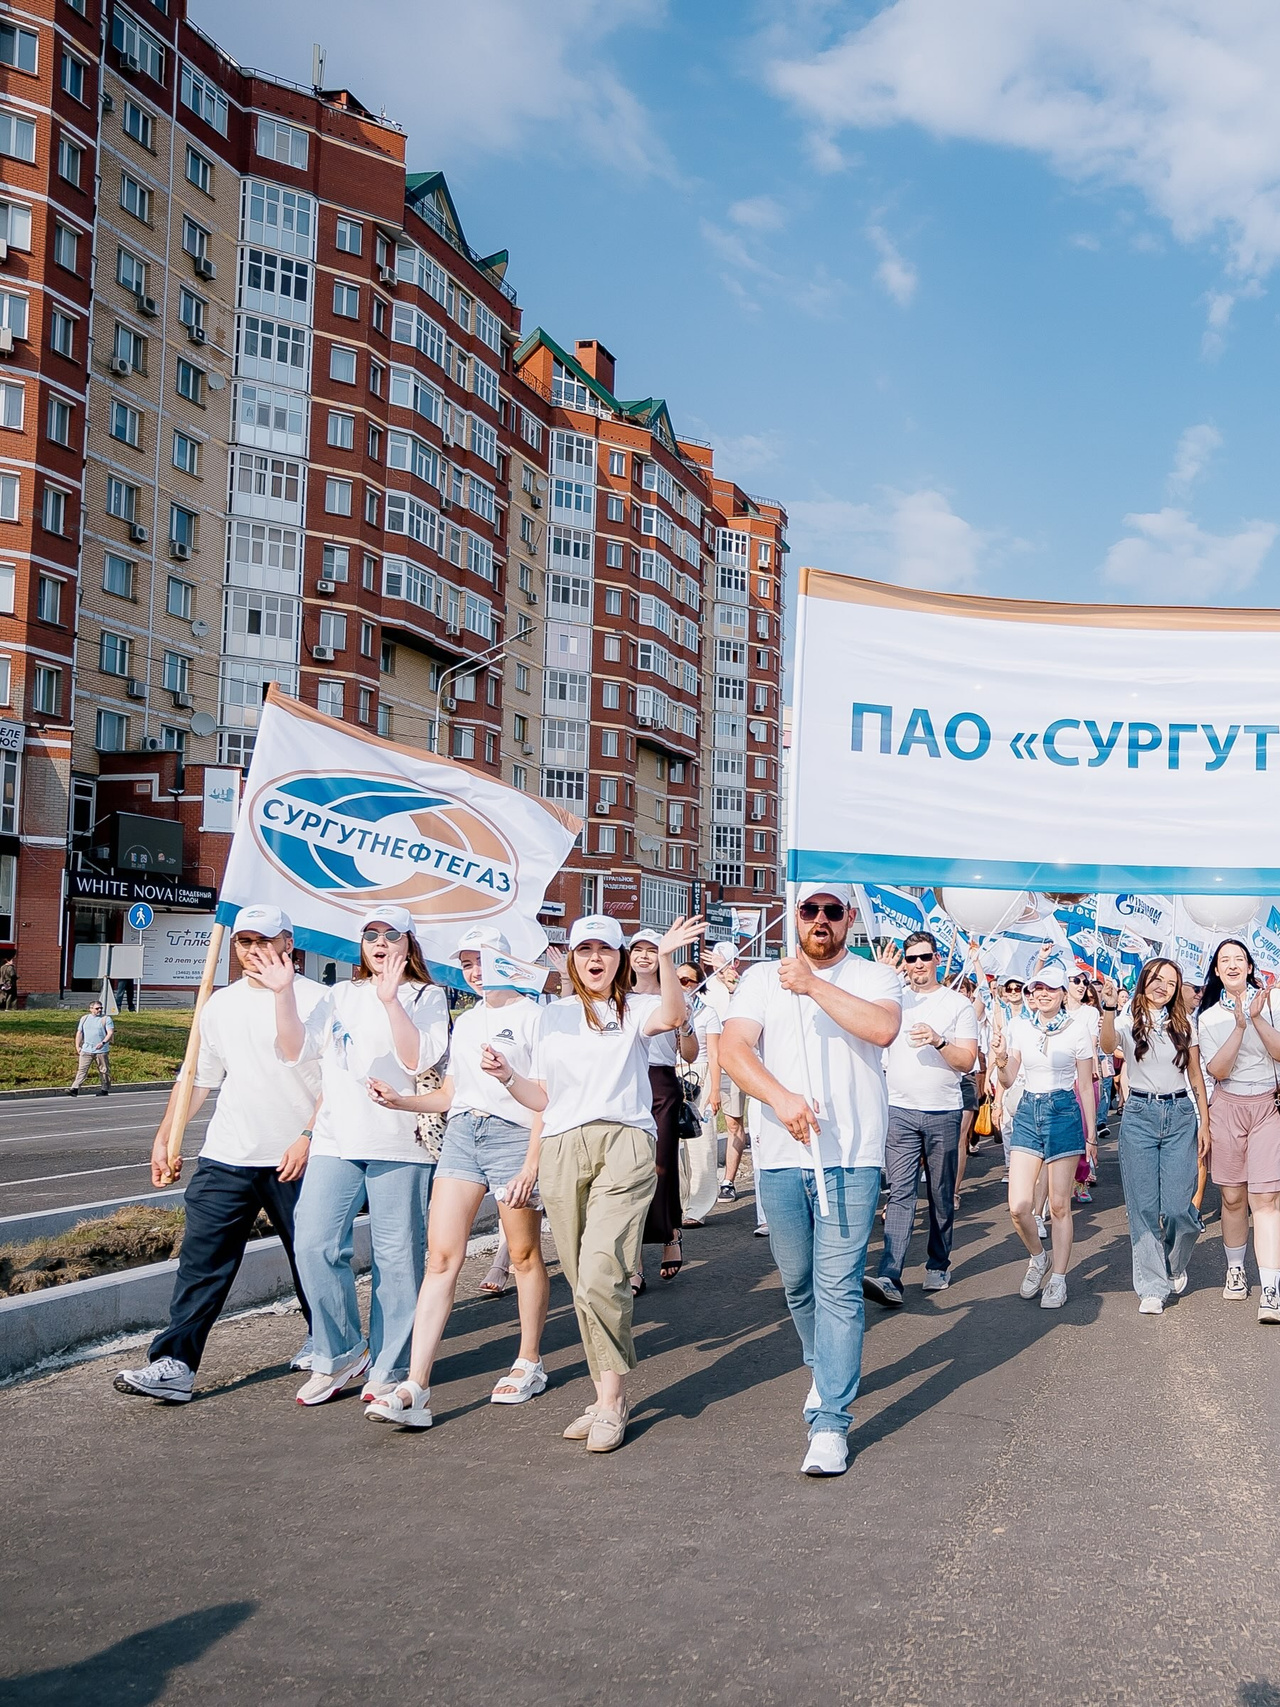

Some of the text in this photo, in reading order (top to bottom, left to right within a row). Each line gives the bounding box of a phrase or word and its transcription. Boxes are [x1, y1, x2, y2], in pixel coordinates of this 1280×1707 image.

[0, 727, 21, 739] ЕЛЕ
[851, 701, 992, 762] ПАО
[0, 737, 18, 749] ЮС
[263, 799, 511, 893] СУРГУТНЕФТЕГАЗ
[76, 877, 174, 902] WHITE NOVA
[178, 889, 212, 899] СВАДЕБНЫЙ
[178, 896, 199, 904] САЛОН
